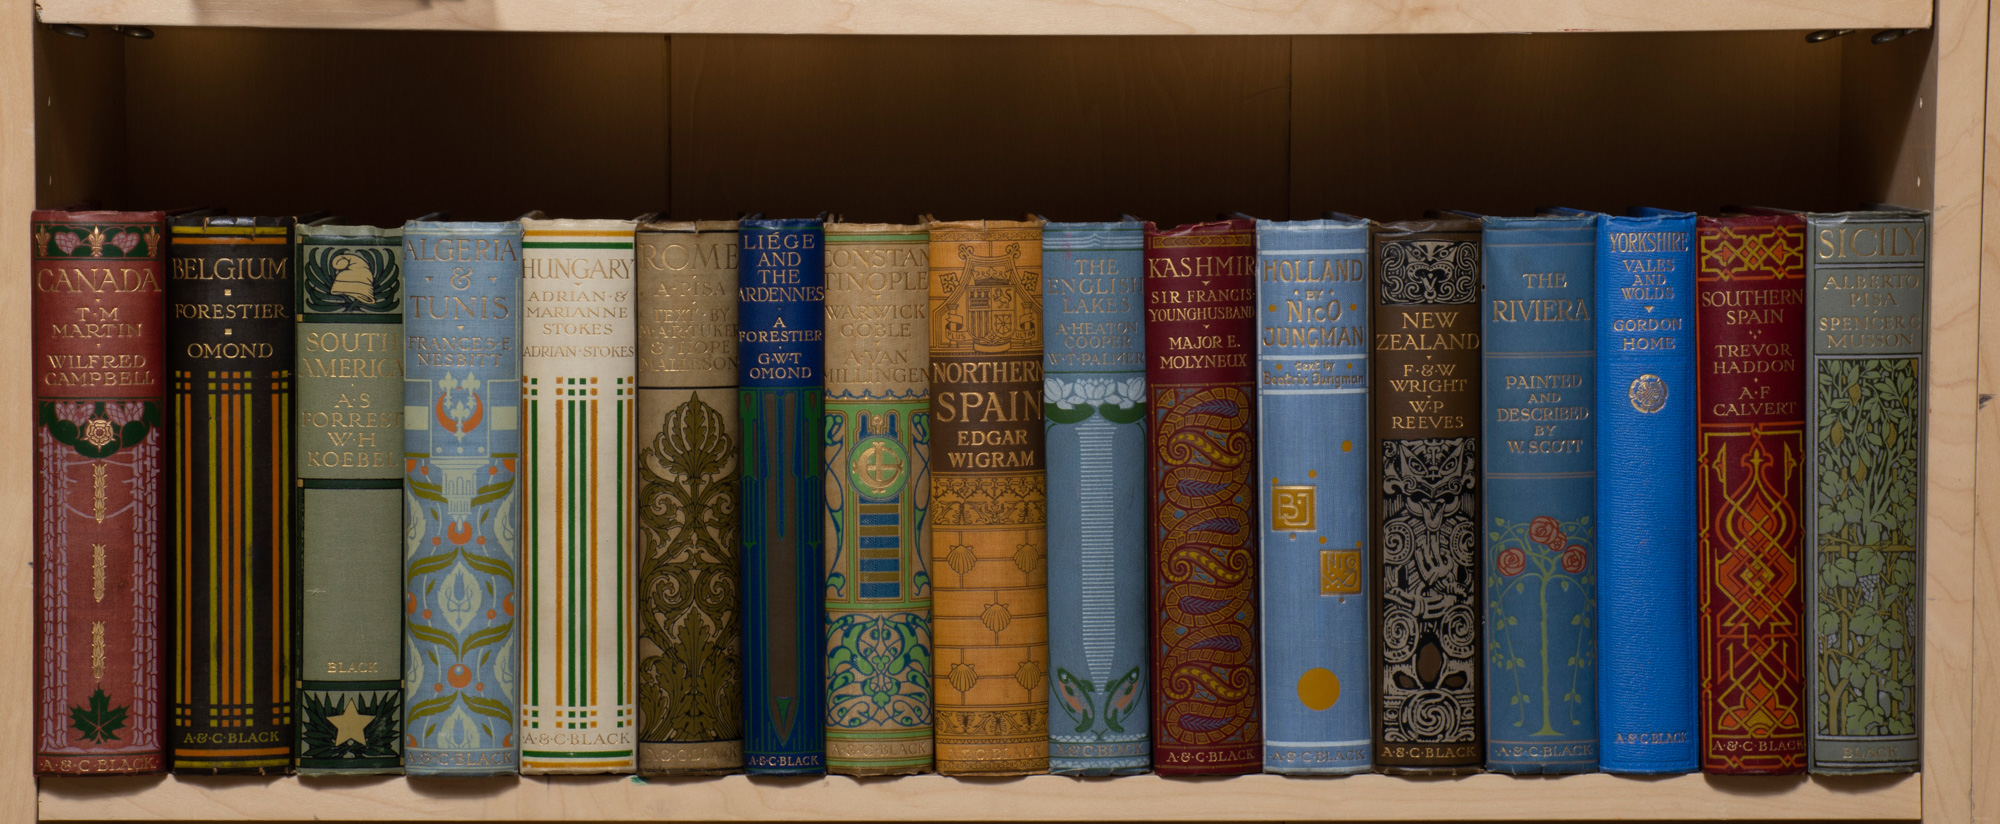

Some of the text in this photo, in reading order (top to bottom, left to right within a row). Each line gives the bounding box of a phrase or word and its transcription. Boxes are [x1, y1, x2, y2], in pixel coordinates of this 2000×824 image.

[404, 238, 517, 262] ALGERIA
[1610, 232, 1689, 253] YORKSHIRE
[1818, 227, 1925, 259] SICILY
[640, 243, 738, 270] ROME
[757, 252, 801, 267] AND
[172, 257, 288, 279] BELGIUM
[522, 258, 634, 279] HUNGARY
[1074, 259, 1119, 275] THE
[1149, 255, 1255, 278] KASHMIR
[1263, 259, 1363, 282] HOLLAND
[1622, 259, 1674, 273] VALES
[37, 268, 162, 293] CANADA
[451, 267, 472, 290] &
[758, 270, 801, 284] THE
[1523, 273, 1568, 288] THE
[1632, 274, 1667, 286] AND
[1823, 274, 1919, 290] ALBERTO
[1048, 278, 1144, 295] ENGLISH
[1621, 287, 1674, 300] WOLDS
[528, 291, 605, 302] ADRIAN
[739, 287, 825, 302] ARDENNES
[1152, 291, 1182, 304] SIR
[1306, 290, 1324, 300] BY
[1702, 289, 1803, 307] SOUTHERN
[1850, 292, 1897, 307] PISA
[175, 304, 289, 319] FORESTIER
[409, 296, 509, 319] TUNIS
[527, 307, 628, 318] MARIANNE
[825, 304, 926, 320] WARWICK
[1063, 297, 1130, 314] LAKES
[1492, 299, 1590, 322] RIVIERA
[1149, 306, 1254, 323] YOUNGHUSBAND
[1402, 312, 1459, 329] NEW
[1726, 309, 1784, 325] SPAIN
[543, 324, 613, 335] STOKES
[773, 317, 786, 328] A
[1613, 318, 1682, 331] GORDON
[52, 324, 142, 338] MARTIN
[739, 330, 822, 342] FORESTIER
[840, 323, 911, 338] GOBLE
[1263, 326, 1364, 348] JUNGMAN
[306, 333, 399, 352] SOUTH
[1065, 336, 1132, 349] COOPER
[1169, 336, 1223, 350] MAJOR
[1376, 334, 1480, 351] ZEALAND
[1623, 337, 1676, 351] HOME
[1827, 334, 1913, 349] MUSSON
[187, 343, 273, 359] OMOND
[1715, 343, 1792, 358] TREVOR
[47, 355, 146, 369] WILFRED
[418, 353, 502, 367] NESBITT
[640, 358, 738, 371] MALLESON
[1160, 354, 1247, 369] MOLYNEUX
[1294, 360, 1335, 372] text by
[1713, 359, 1795, 374] HADDON
[299, 358, 404, 378] AMERICA
[750, 367, 811, 379] OMOND
[932, 361, 1043, 384] NORTHERN
[45, 371, 154, 386] CAMPBELL
[1263, 372, 1364, 388] Beatrix Jungman
[1390, 379, 1467, 393] WRIGHT
[1505, 375, 1582, 389] PAINTED
[1527, 393, 1561, 404] AND
[937, 390, 1042, 423] SPAIN
[1497, 406, 1589, 422] DESCRIBED
[1713, 402, 1797, 416] CALVERT
[1392, 416, 1464, 429] REEVES
[958, 430, 1028, 446] EDGAR
[1534, 425, 1557, 436] BY
[308, 452, 398, 468] KOEBEL
[948, 451, 1034, 469] WIGRAM
[328, 661, 378, 674] BLACK
[1842, 745, 1899, 759] BLACK
